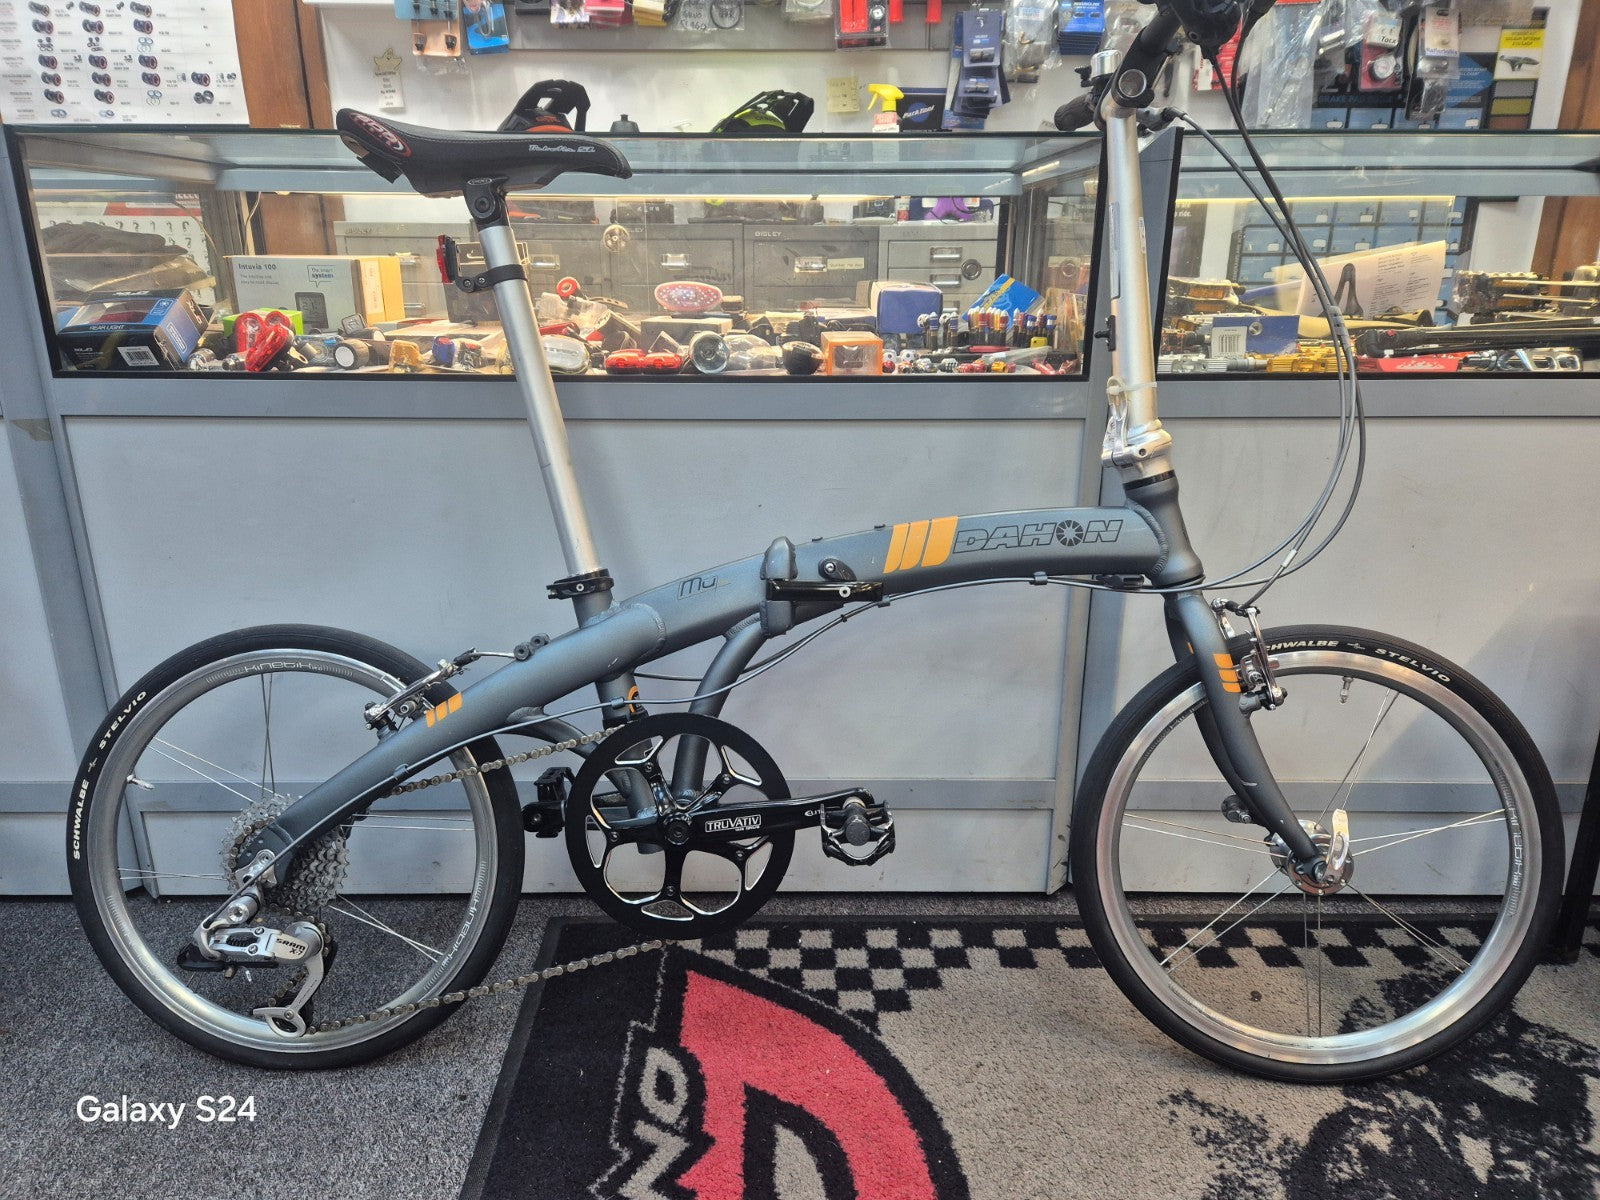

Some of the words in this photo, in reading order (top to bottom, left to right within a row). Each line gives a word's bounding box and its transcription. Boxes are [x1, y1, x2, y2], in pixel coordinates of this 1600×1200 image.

[754, 230, 783, 238] BISLEY
[952, 519, 1124, 554] DAHON
[1374, 648, 1452, 683] STELVIO
[72, 778, 90, 860] SCHWALBE
[98, 690, 147, 750] STELVIO
[706, 815, 760, 831] TRUVATIV
[275, 938, 306, 951] SRAM
